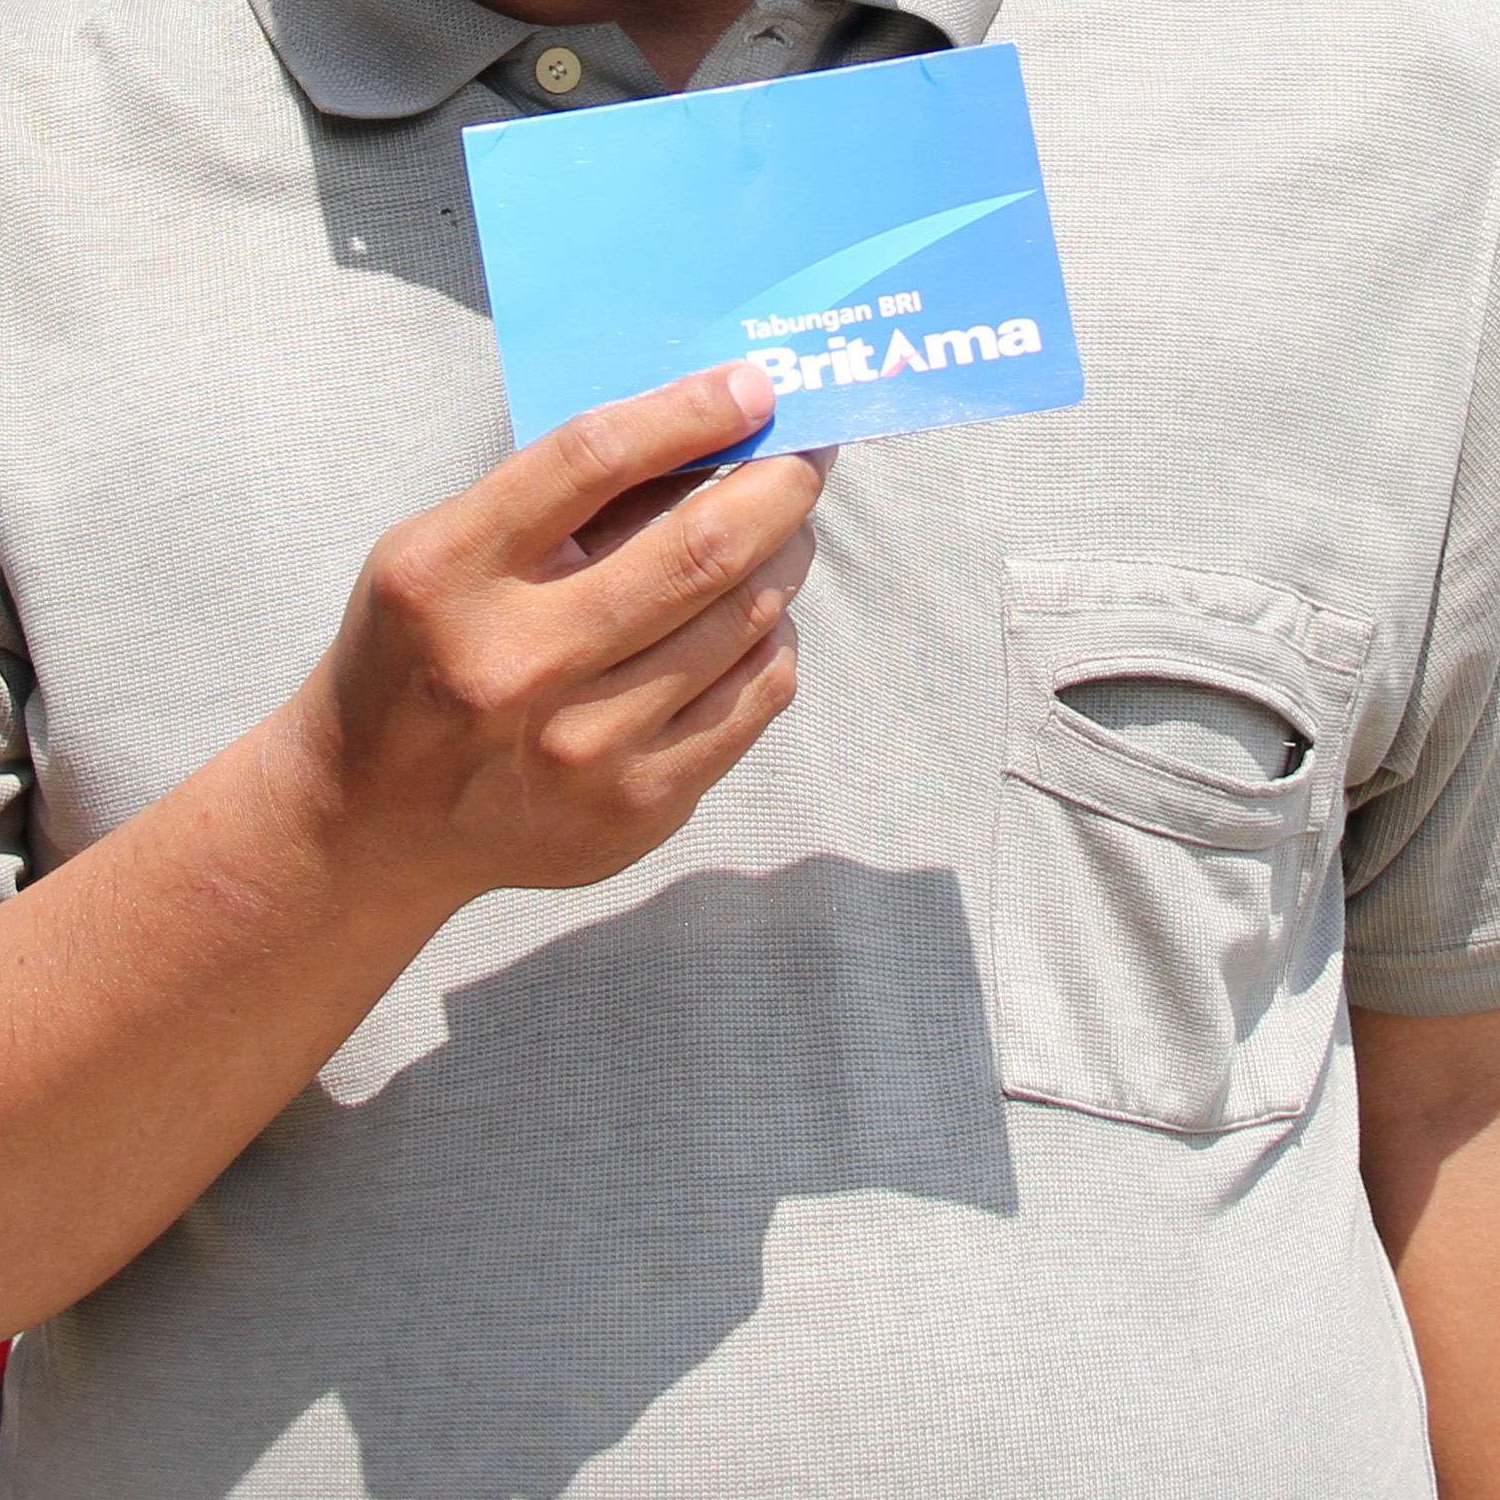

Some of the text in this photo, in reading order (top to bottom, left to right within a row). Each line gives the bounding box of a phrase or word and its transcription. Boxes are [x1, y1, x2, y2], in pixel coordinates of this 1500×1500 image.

[740, 290, 923, 340] Tabungan BRI
[746, 317, 1043, 396] BritAma
